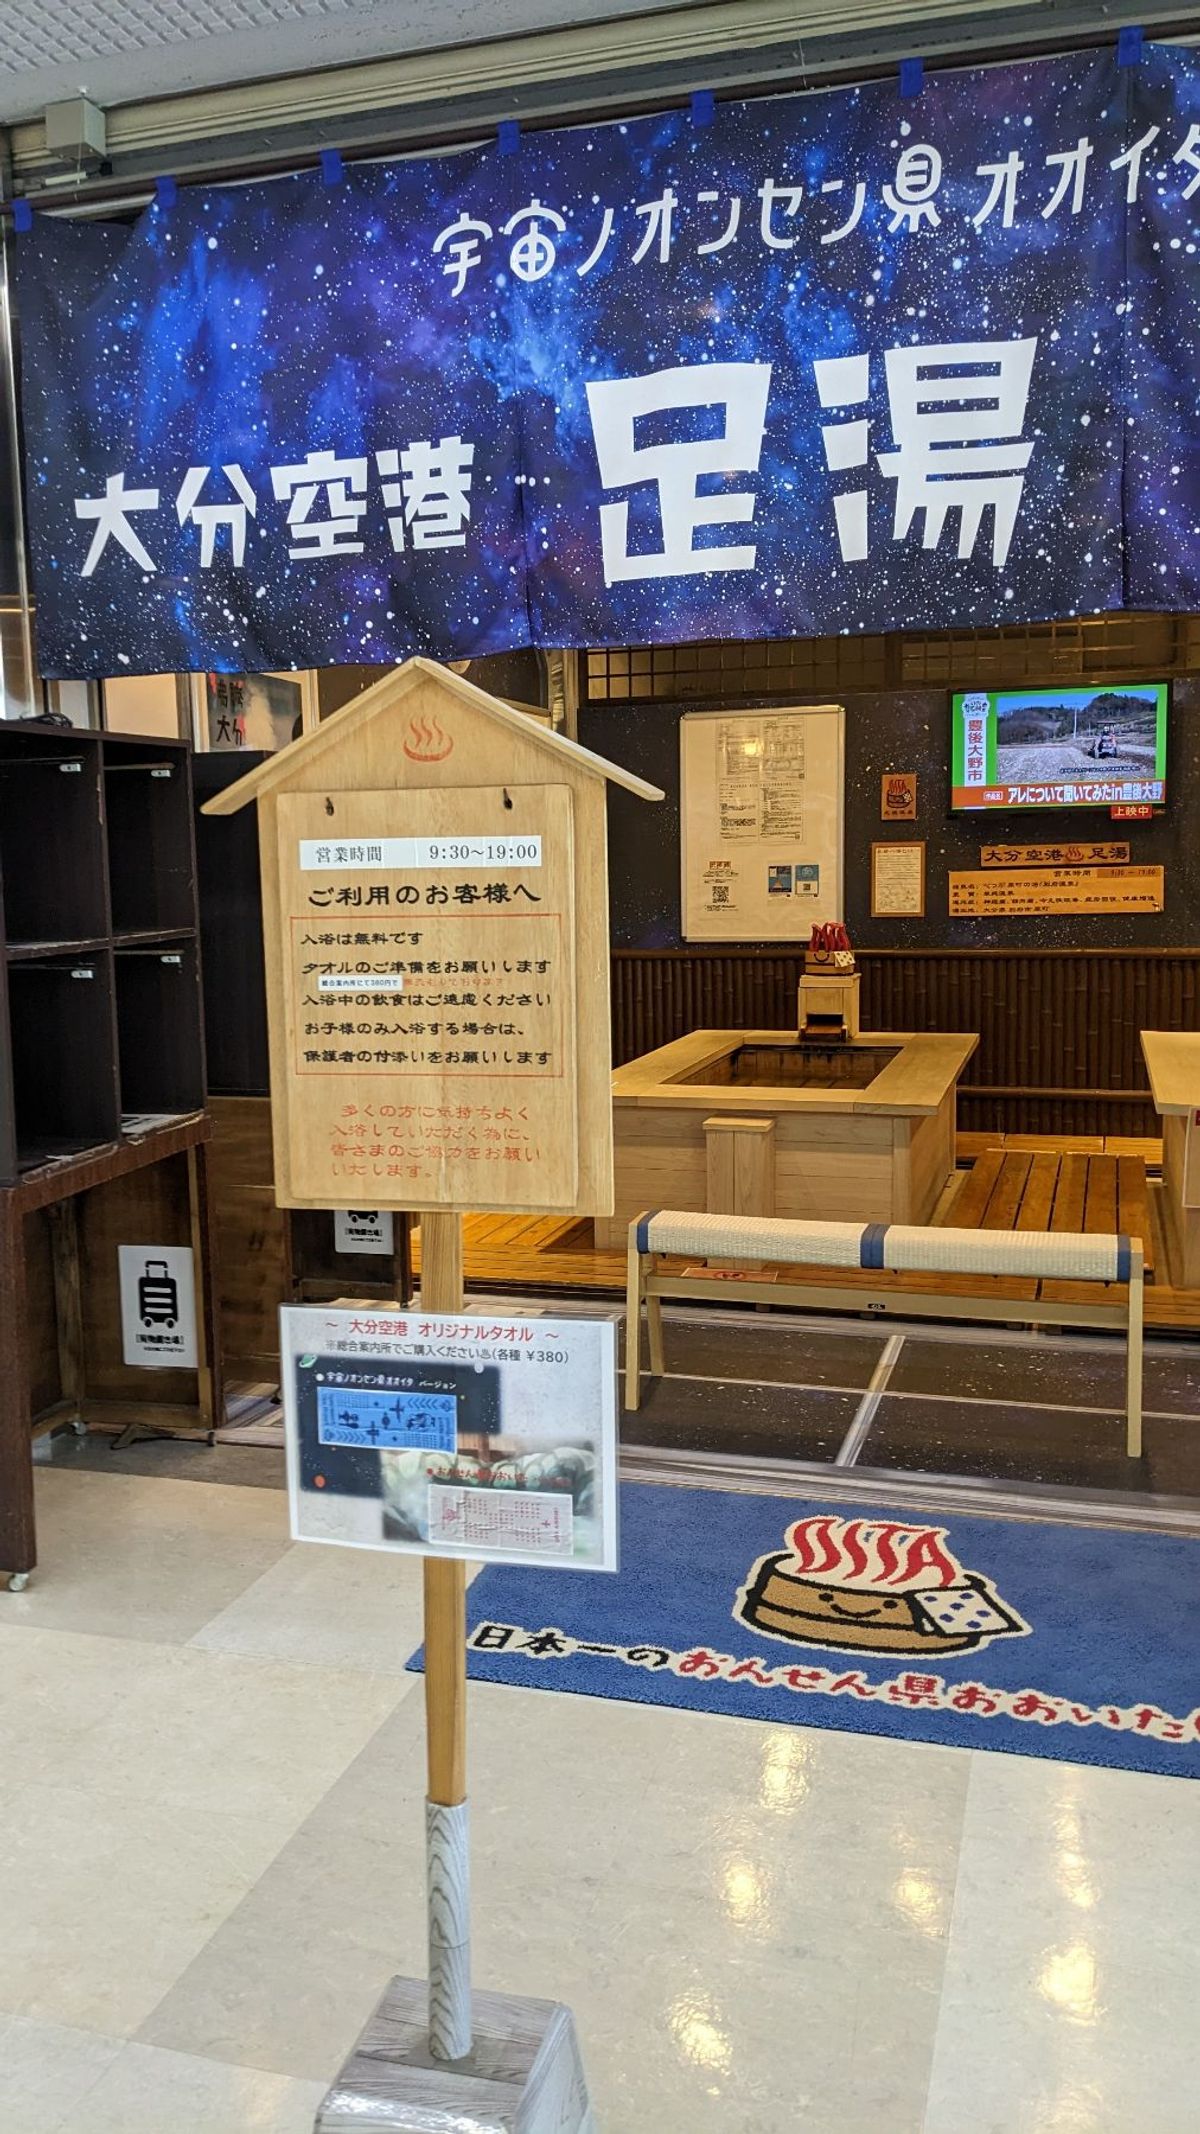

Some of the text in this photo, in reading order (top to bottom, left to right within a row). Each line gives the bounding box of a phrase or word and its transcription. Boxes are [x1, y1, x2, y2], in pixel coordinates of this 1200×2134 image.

[75, 336, 1037, 583] 大分空港 足湯
[1114, 806, 1149, 816] 上映中
[316, 846, 382, 863] 営業時間
[1088, 847, 1127, 859] 足湯
[308, 883, 541, 907] ご利用のお客様へ
[300, 931, 423, 946] 入浴は無料です
[302, 960, 551, 974] タオルのご準備をお願いします
[302, 993, 551, 1007] 入浴中の飲食はご遠慮ください
[304, 1021, 524, 1036] お子様のみ入浴する場合は、
[304, 1049, 552, 1065] 保護者の付添いをお願いします
[341, 1104, 529, 1121] 多くの方に気持ちよく
[331, 1143, 540, 1162] 皆さまのご協力をお願い
[332, 1163, 433, 1178] いたします。
[349, 1319, 408, 1337] 大分空港
[418, 1325, 534, 1342] オリジナルタオル
